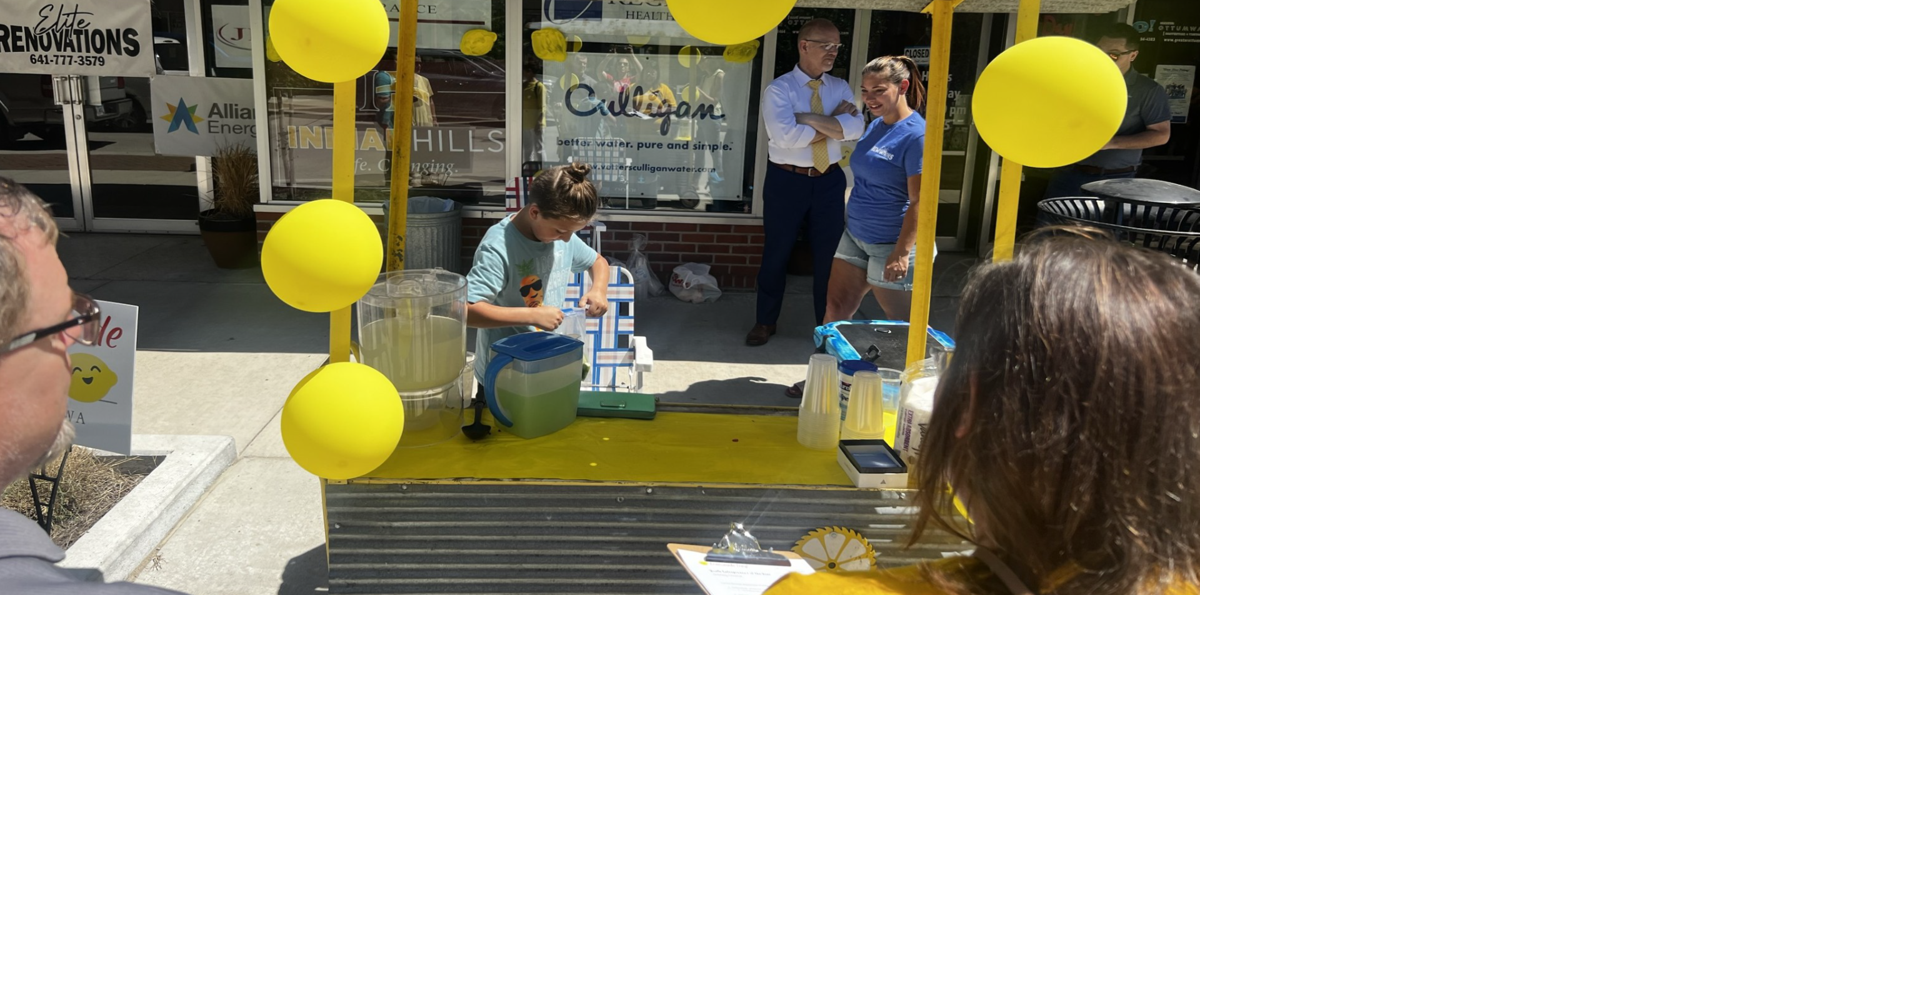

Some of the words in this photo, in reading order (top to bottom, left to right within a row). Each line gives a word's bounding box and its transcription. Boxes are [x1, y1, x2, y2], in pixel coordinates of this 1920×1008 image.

[33, 4, 94, 39] Elite
[0, 24, 140, 57] RENOVATIONS
[30, 54, 105, 66] 641-777-3579
[905, 49, 930, 58] CLOSED
[208, 102, 256, 120] Allia
[564, 83, 726, 136] Culligan
[208, 120, 257, 138] Energ
[413, 129, 504, 153] HILLS
[557, 138, 591, 147] better
[595, 140, 633, 149] water.
[637, 141, 663, 151] pure
[666, 141, 689, 150] and
[692, 141, 733, 152] simple.
